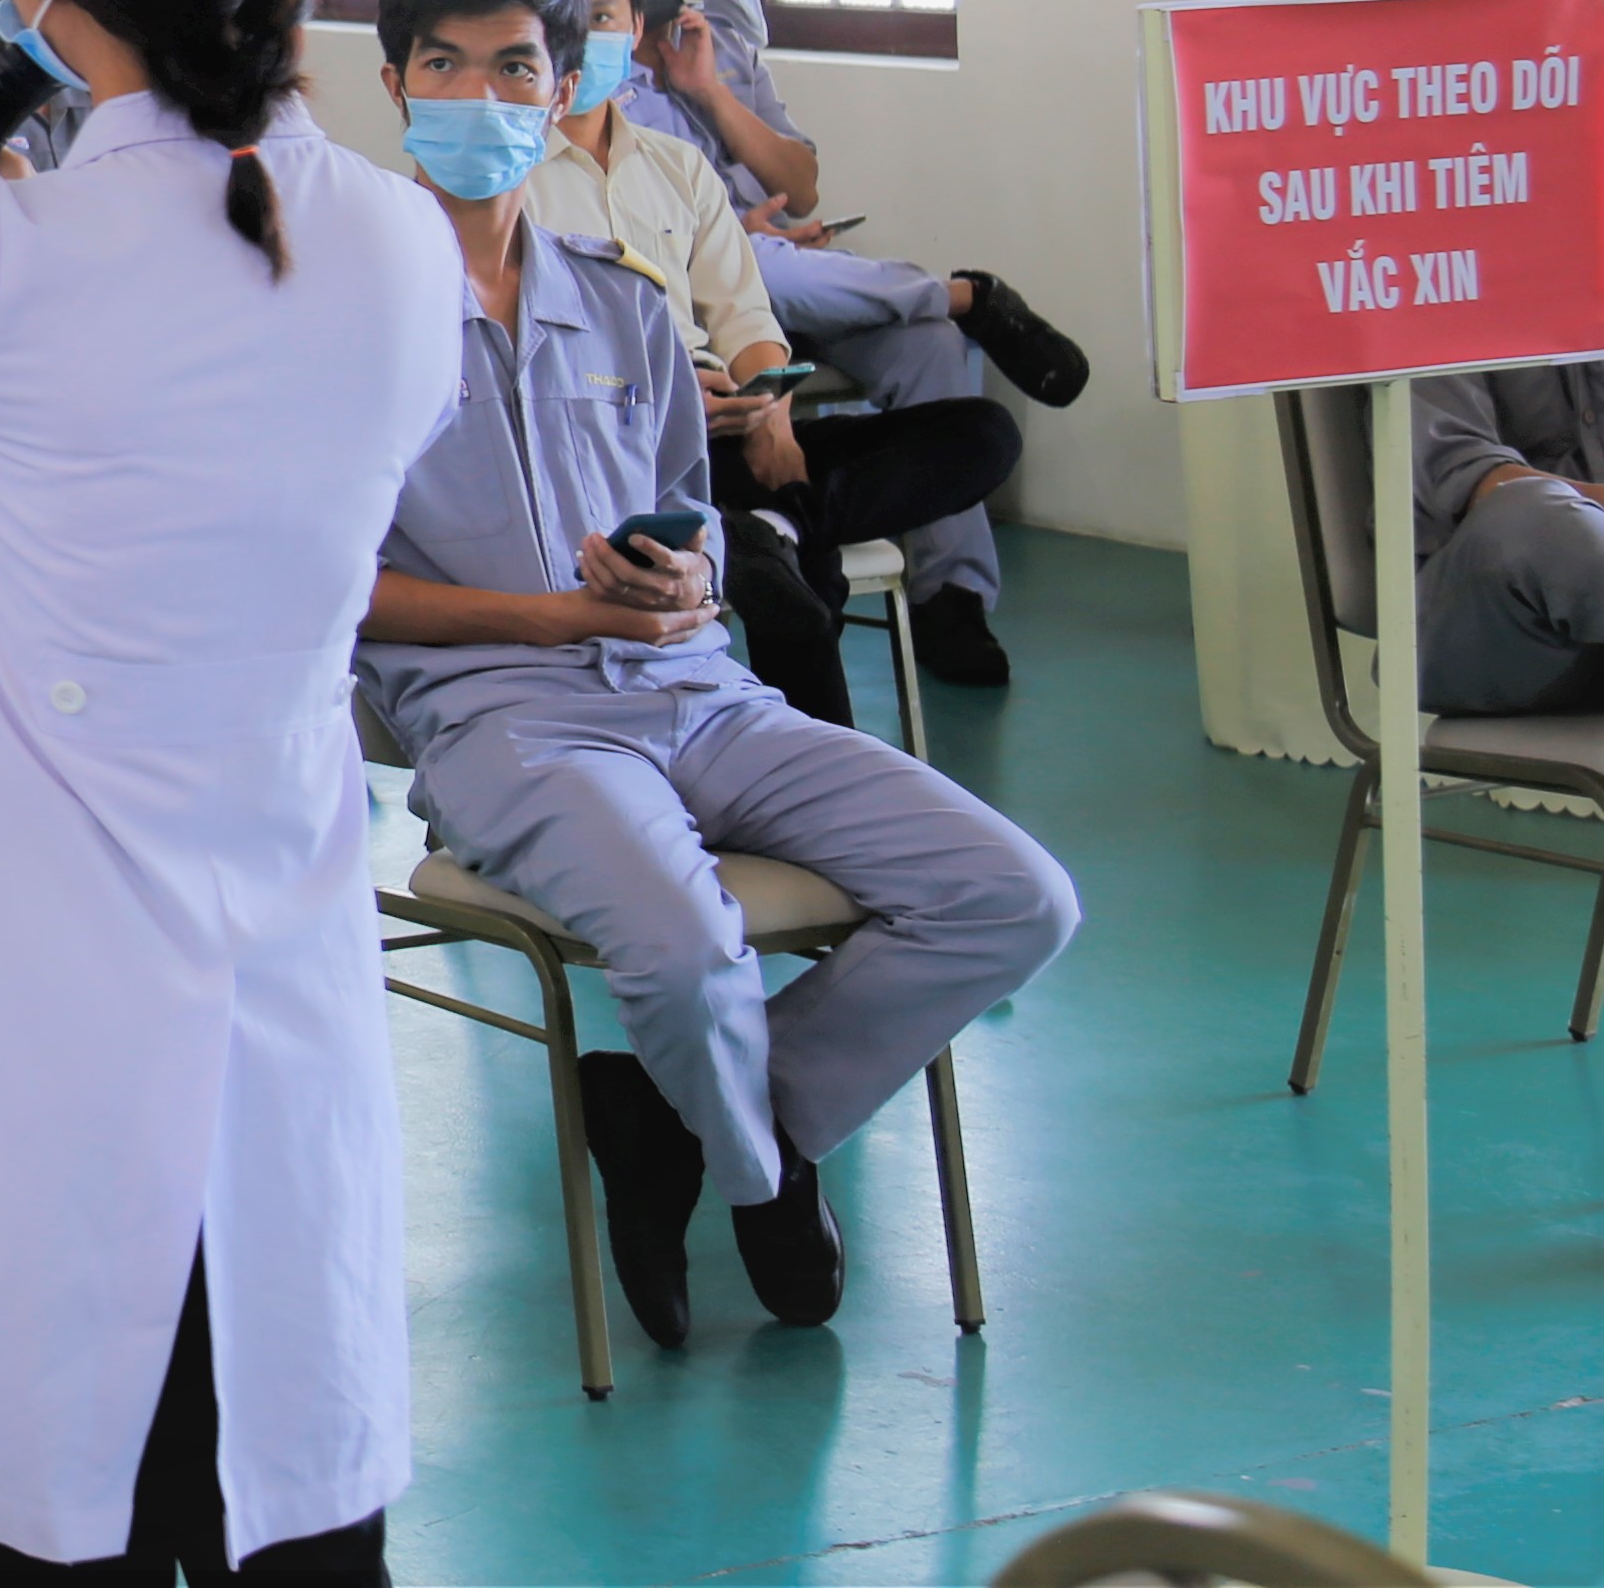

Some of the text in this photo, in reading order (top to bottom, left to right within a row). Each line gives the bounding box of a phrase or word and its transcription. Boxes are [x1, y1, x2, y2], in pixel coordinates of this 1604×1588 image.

[1204, 45, 1580, 137] KHU VỰC THEO DÕI
[1258, 142, 1529, 226] SAU KHI TIÊM
[1316, 239, 1480, 314] VẮC XIN
